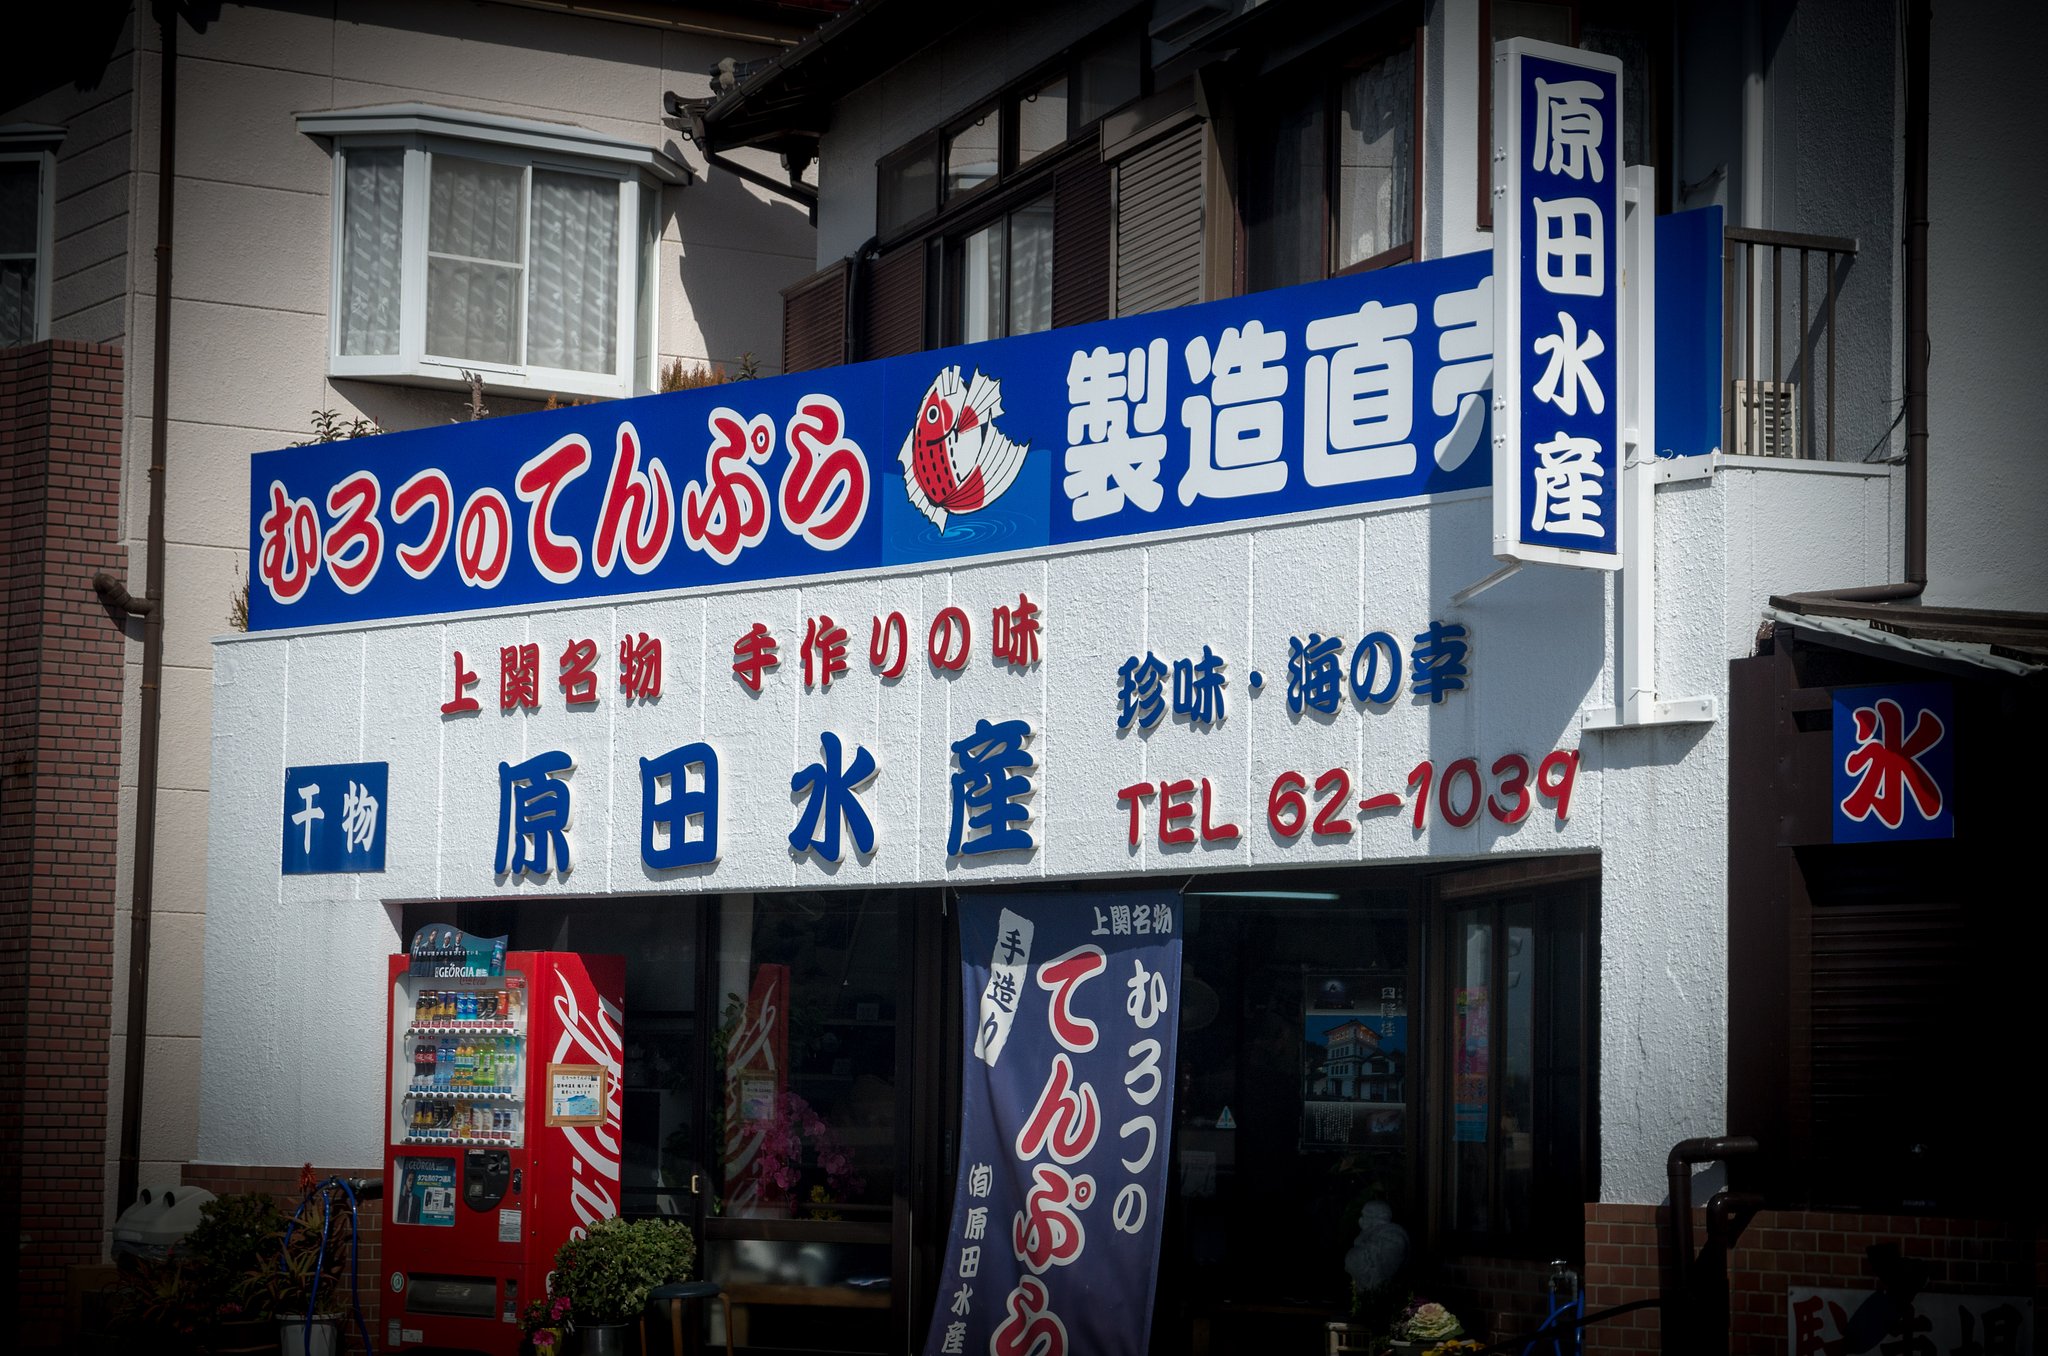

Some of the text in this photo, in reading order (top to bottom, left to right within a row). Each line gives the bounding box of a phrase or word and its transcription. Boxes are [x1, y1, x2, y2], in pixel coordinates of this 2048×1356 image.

[1532, 77, 1605, 538] 原田水産
[258, 393, 870, 605] むろつのてんぷら
[441, 594, 1041, 716] 上関名物 手作りの味
[291, 779, 380, 855] 干物
[494, 719, 1039, 876] 原田水産
[1117, 749, 1581, 846] TEL 62-1039
[1840, 698, 1944, 829] 氷
[438, 964, 474, 978] GEORGIA
[1091, 904, 1173, 936] 上関名物
[983, 930, 1026, 1048] 手造り
[990, 944, 1106, 1356] てんぷら
[1113, 959, 1168, 1234] むろつの
